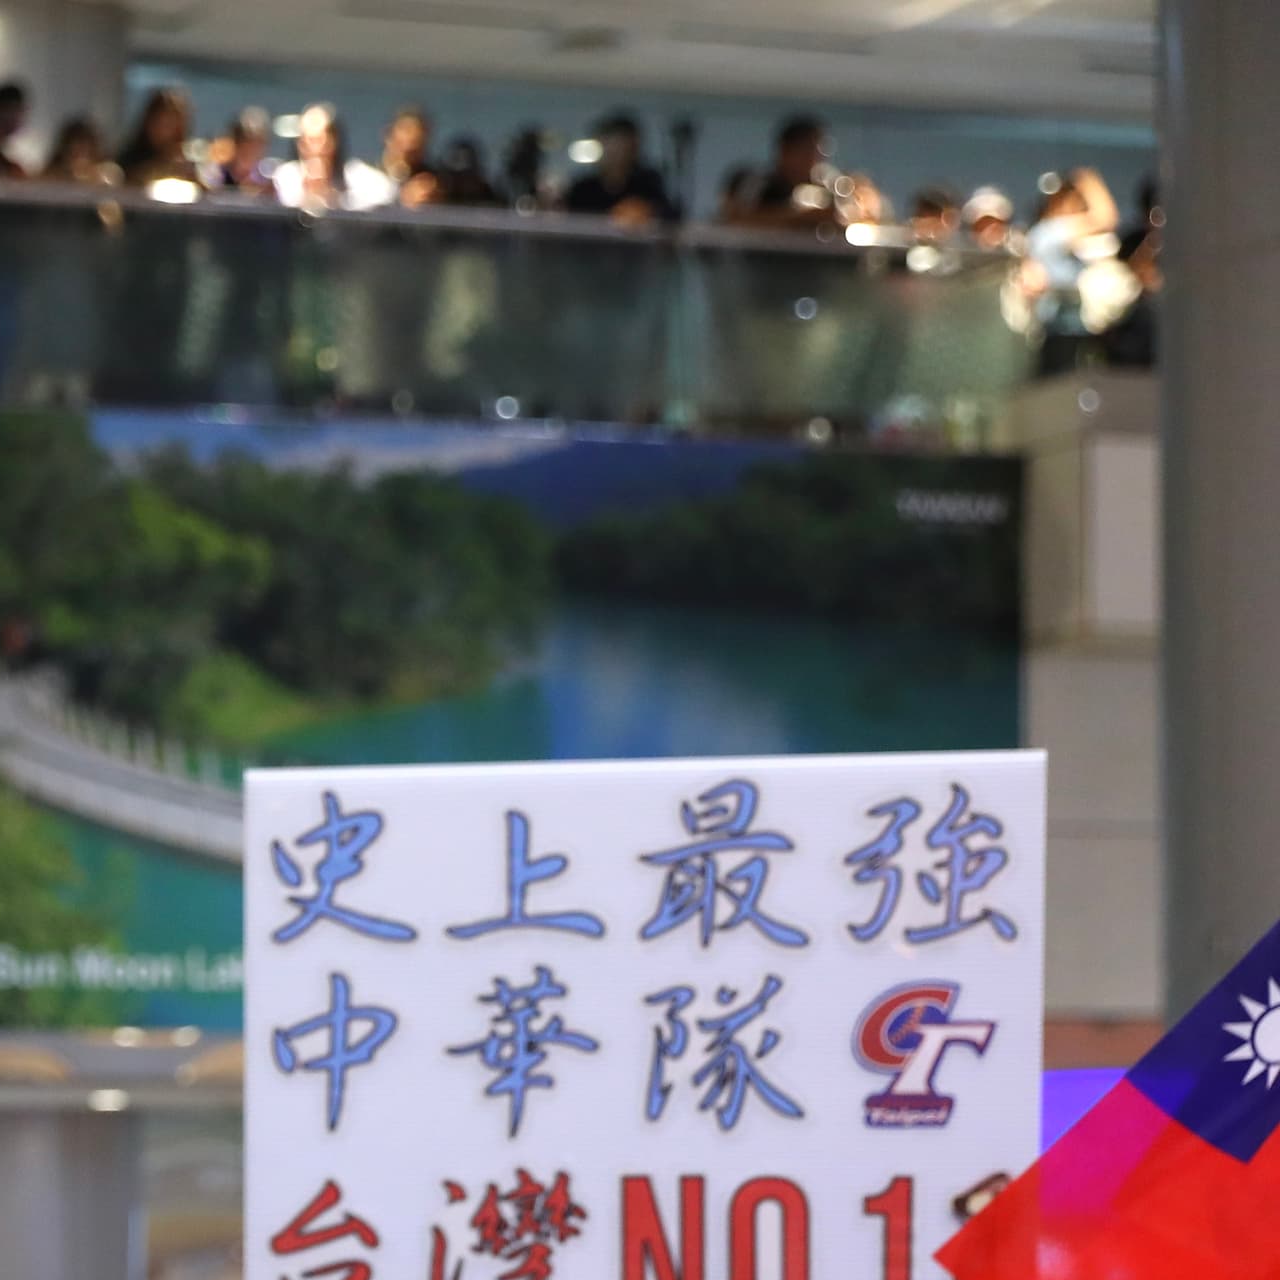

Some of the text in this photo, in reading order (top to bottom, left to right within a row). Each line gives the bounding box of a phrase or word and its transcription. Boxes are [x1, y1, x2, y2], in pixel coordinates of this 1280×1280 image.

[271, 779, 1018, 948] 史上最強
[272, 964, 805, 1138] 中華隊
